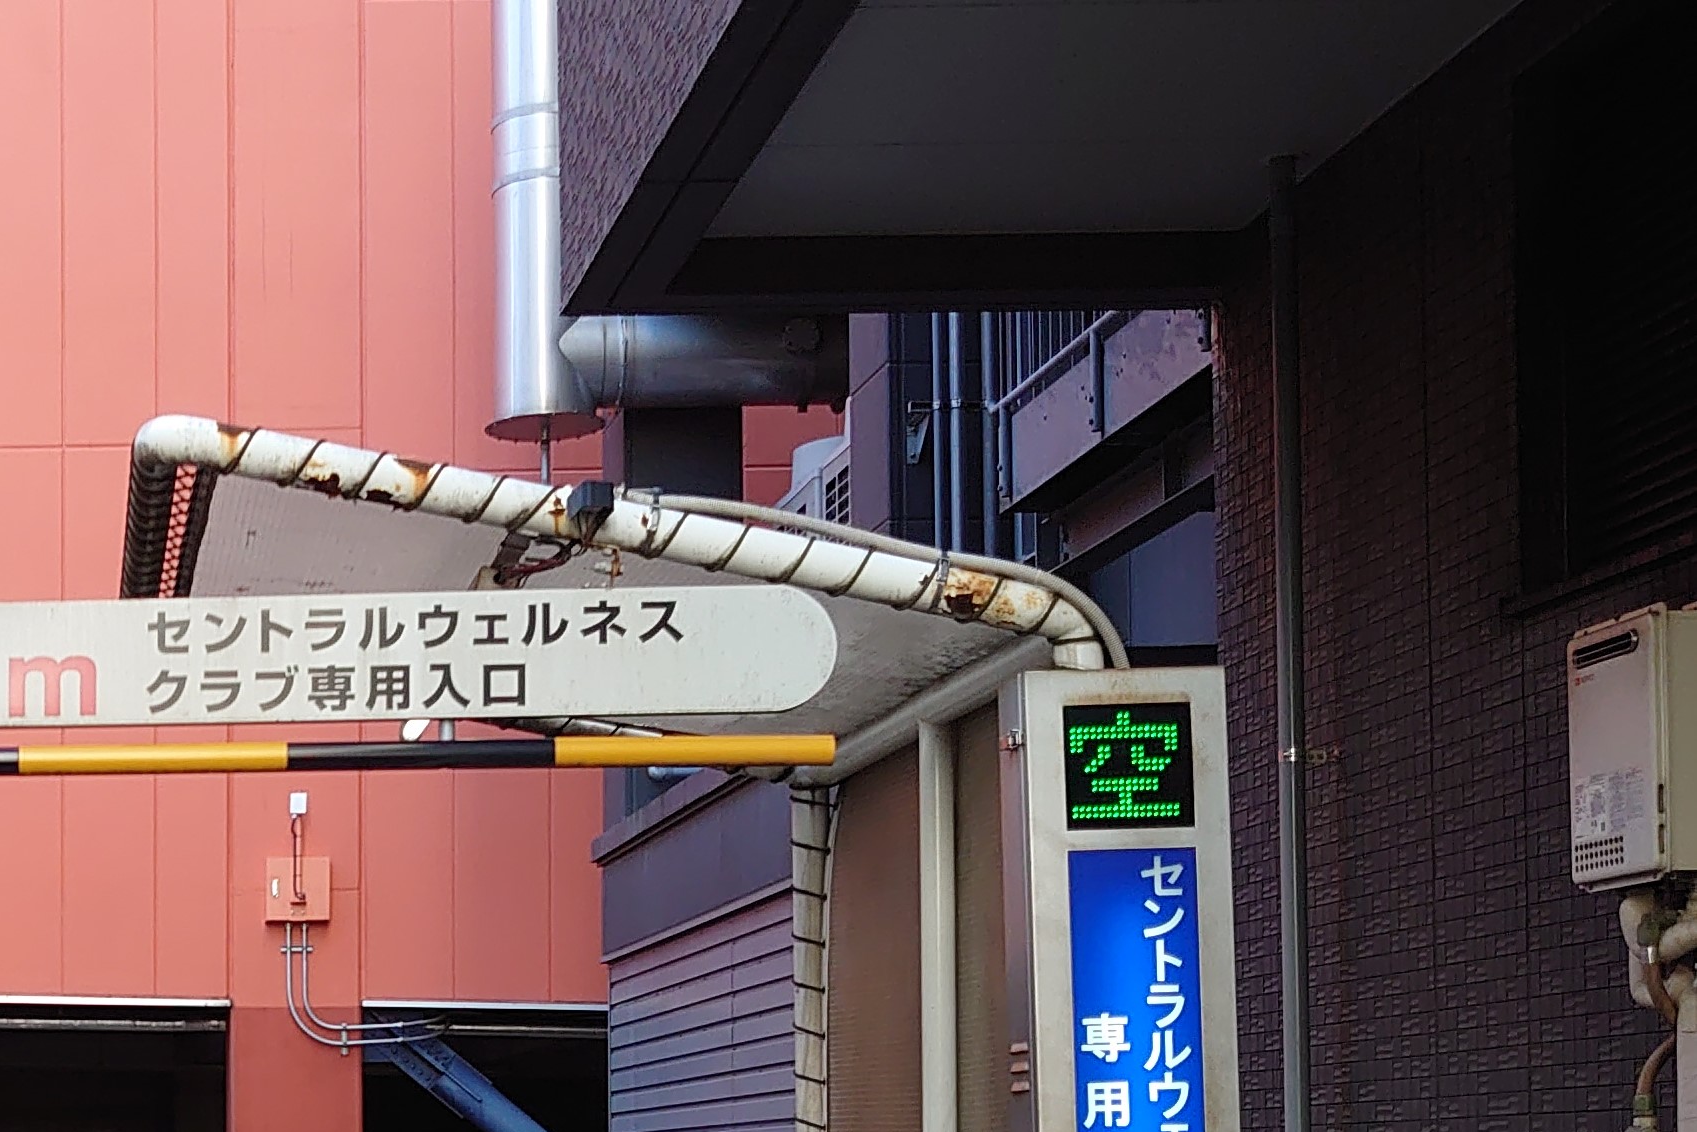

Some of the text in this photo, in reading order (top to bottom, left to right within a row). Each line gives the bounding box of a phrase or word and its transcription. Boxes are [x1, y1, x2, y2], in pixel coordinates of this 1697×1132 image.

[147, 600, 685, 655] セントラルウェルネス
[146, 663, 527, 714] クラブ専用入口
[1069, 710, 1180, 819] 空
